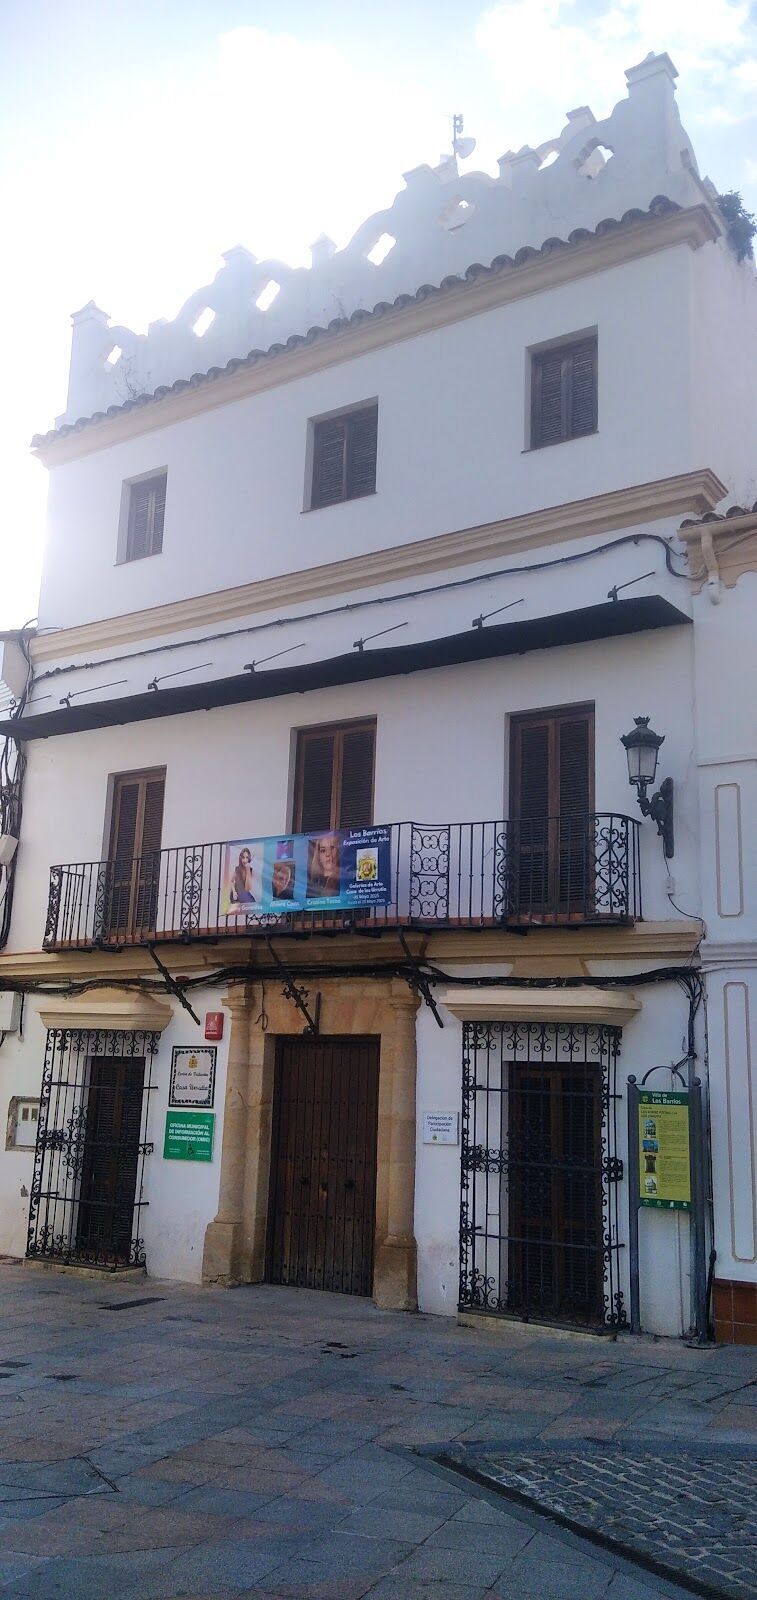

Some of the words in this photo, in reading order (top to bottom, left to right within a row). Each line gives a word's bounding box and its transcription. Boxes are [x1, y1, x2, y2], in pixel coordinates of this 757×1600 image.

[362, 828, 387, 837] Barrios
[343, 838, 369, 846] Exposición
[176, 1083, 188, 1091] Casa
